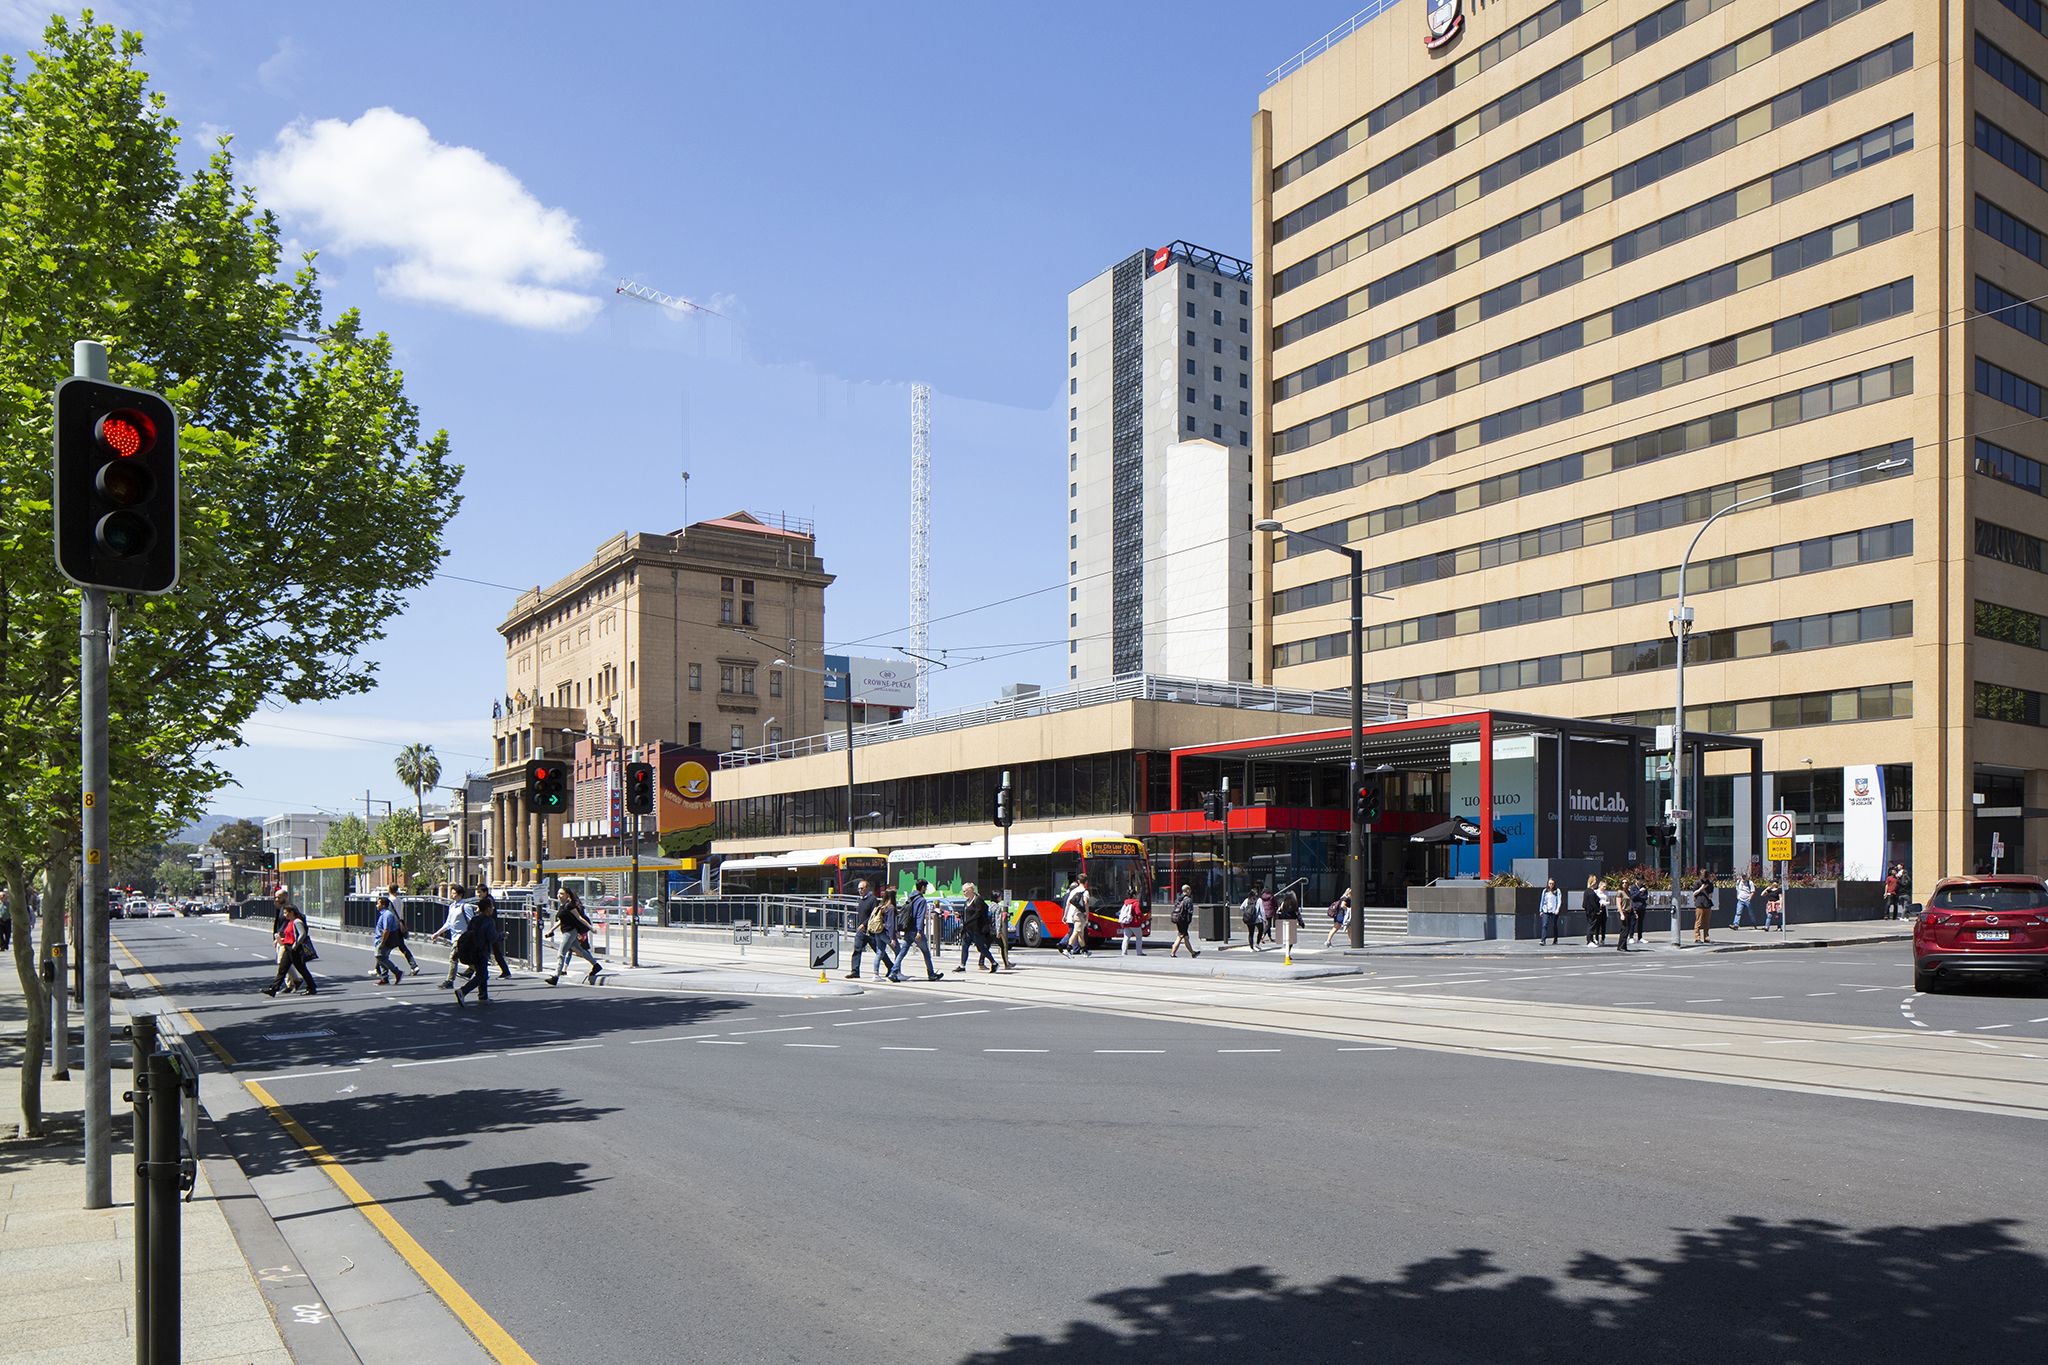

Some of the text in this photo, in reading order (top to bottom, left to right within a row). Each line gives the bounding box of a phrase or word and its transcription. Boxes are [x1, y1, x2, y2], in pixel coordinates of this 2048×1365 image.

[863, 678, 912, 689] CROWNE PLAZA
[85, 793, 94, 806] 8
[1461, 793, 1521, 807] comon.
[1569, 788, 1629, 812] hincLab.
[1771, 821, 1788, 831] 40
[89, 850, 99, 863] 2
